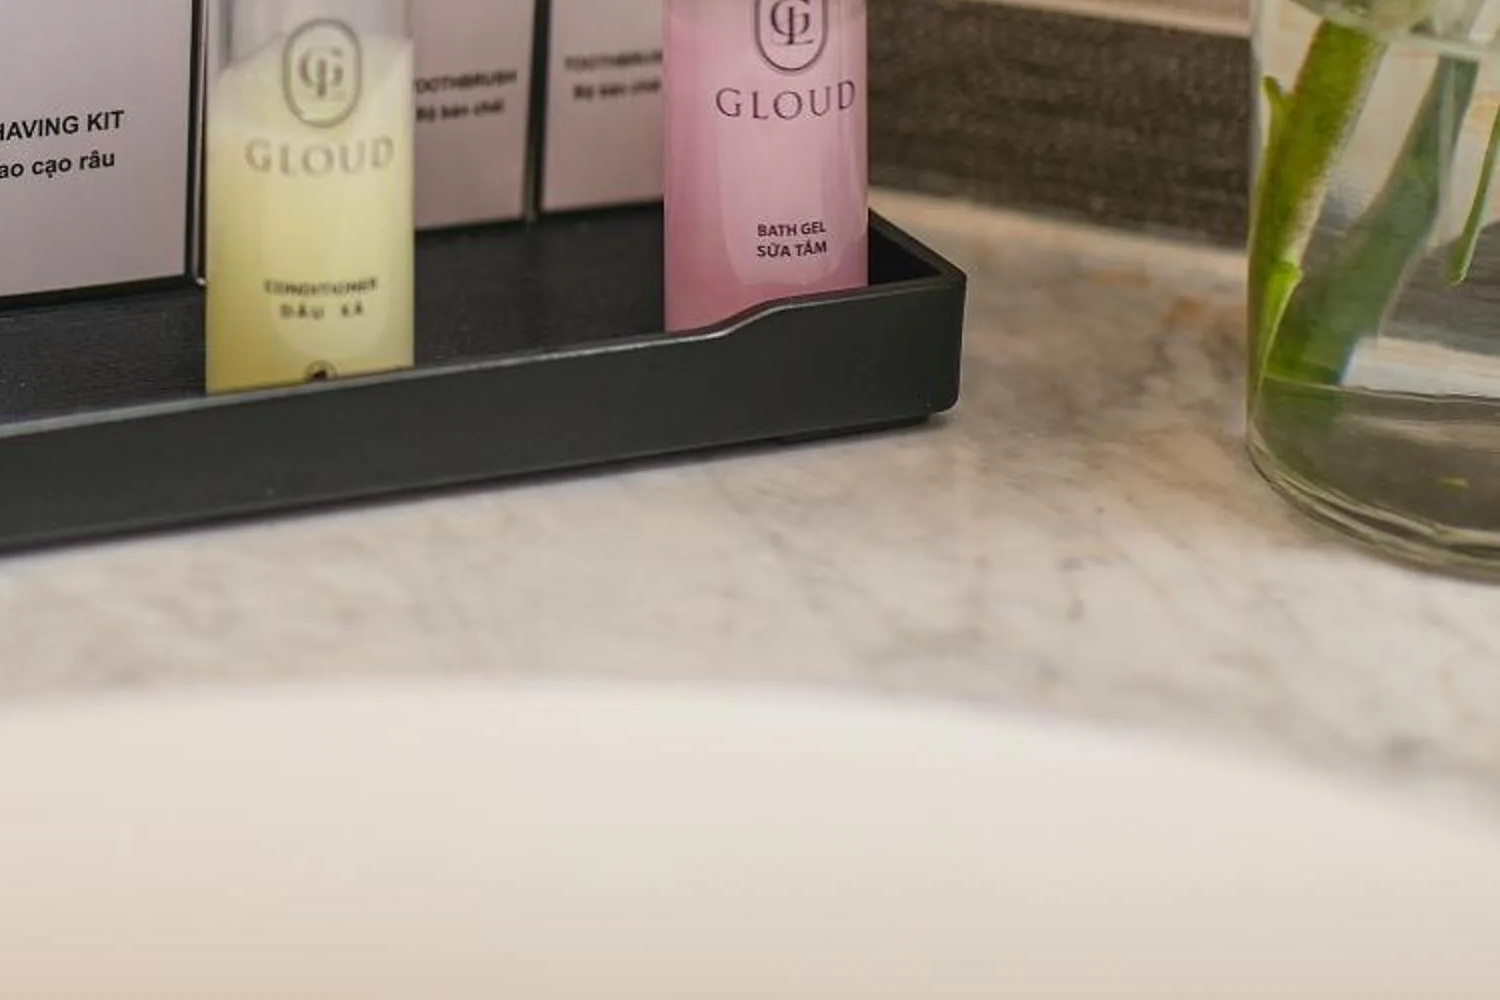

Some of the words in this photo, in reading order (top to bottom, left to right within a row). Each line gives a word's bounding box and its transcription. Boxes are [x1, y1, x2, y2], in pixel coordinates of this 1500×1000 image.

[415, 70, 518, 95] OOTHBRUSH
[715, 79, 856, 120] GLOUD
[87, 110, 125, 132] KIT
[32, 156, 72, 178] cạo
[79, 150, 116, 171] râu
[244, 134, 395, 178] GLOUD
[757, 223, 797, 238] BATH
[801, 219, 828, 236] GEL
